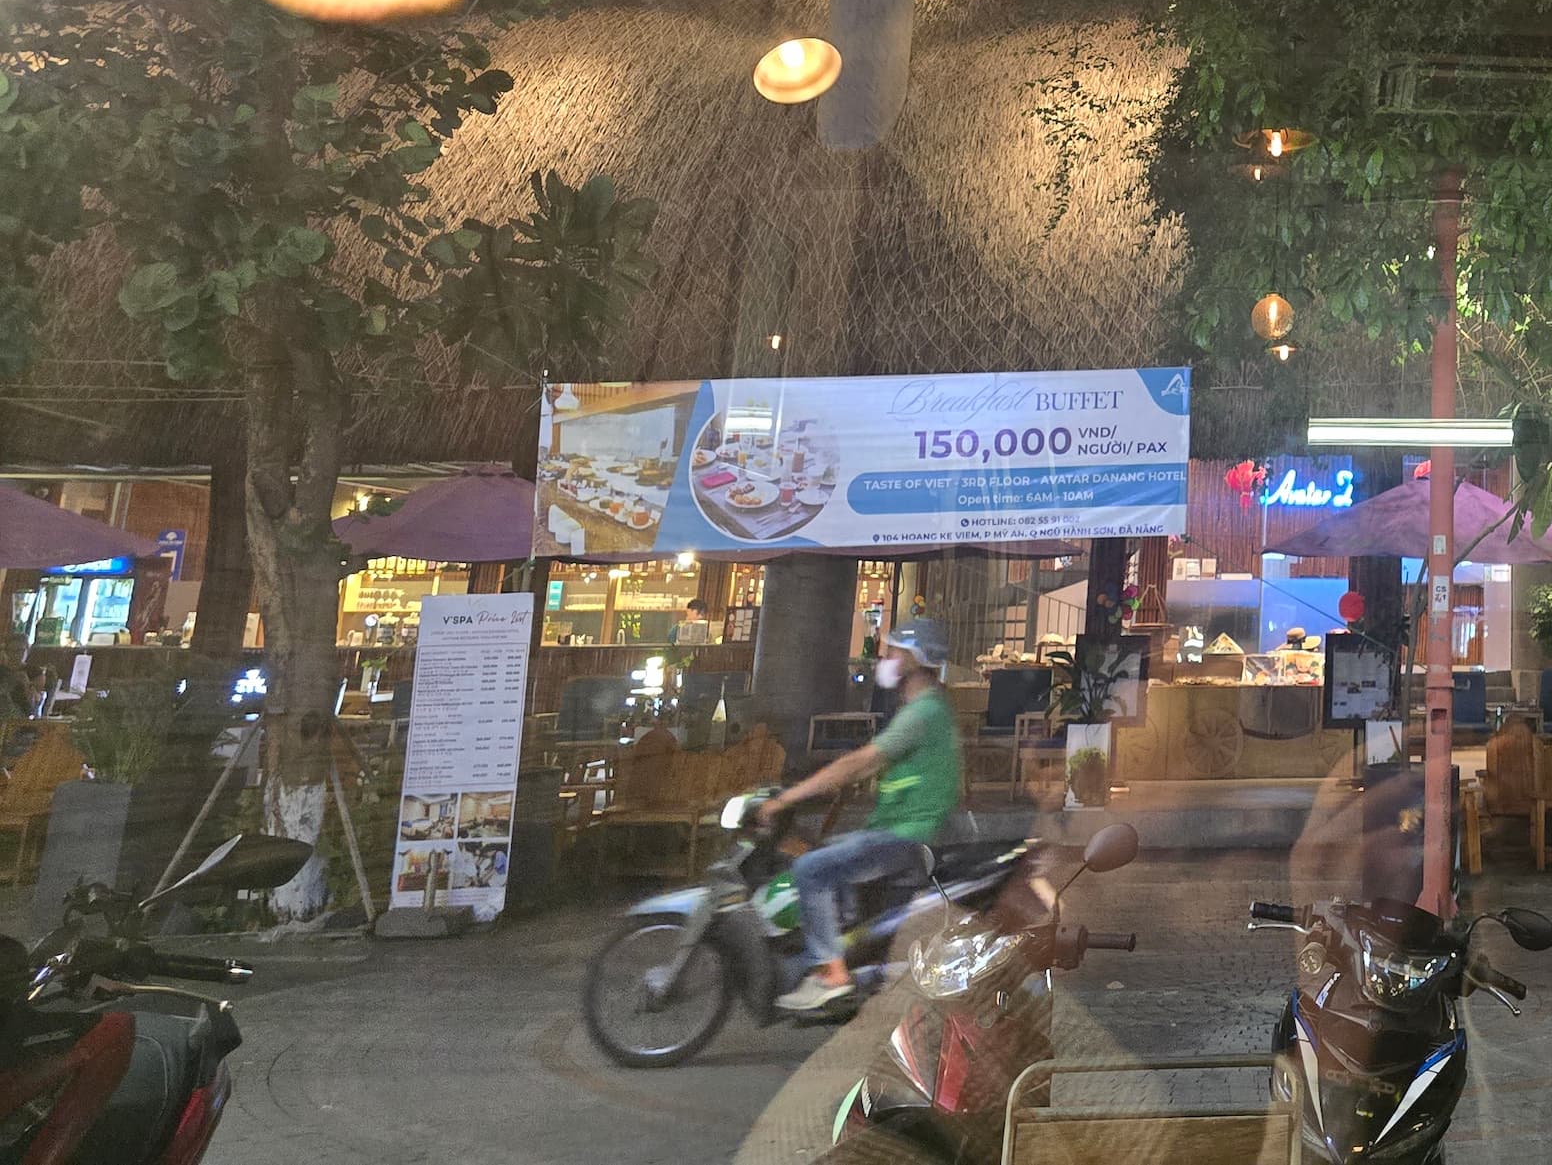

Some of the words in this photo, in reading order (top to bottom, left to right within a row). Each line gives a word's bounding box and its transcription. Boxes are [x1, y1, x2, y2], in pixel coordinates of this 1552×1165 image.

[886, 379, 1036, 424] Breakfast
[1036, 390, 1124, 412] BUFFET
[1078, 425, 1118, 440] VND/
[914, 427, 1072, 463] 150,000
[1078, 440, 1134, 456] NGƯỜI/
[1137, 441, 1168, 454] PAX
[863, 479, 902, 491] TASTE
[904, 479, 923, 490] OF
[924, 477, 952, 489] VIET
[961, 476, 987, 489] 3RD
[989, 475, 1031, 487] FLOOR
[1040, 474, 1090, 486] AVATAR
[1092, 471, 1146, 484] DANANG
[1148, 470, 1187, 482] HOTEL
[1332, 469, 1354, 507] 2
[957, 494, 991, 507] Open
[992, 493, 1024, 504] time:
[1026, 491, 1053, 503] 6AM
[1063, 490, 1094, 502] 10AM
[971, 517, 1017, 527] HOTLINE:
[882, 534, 899, 542] 104
